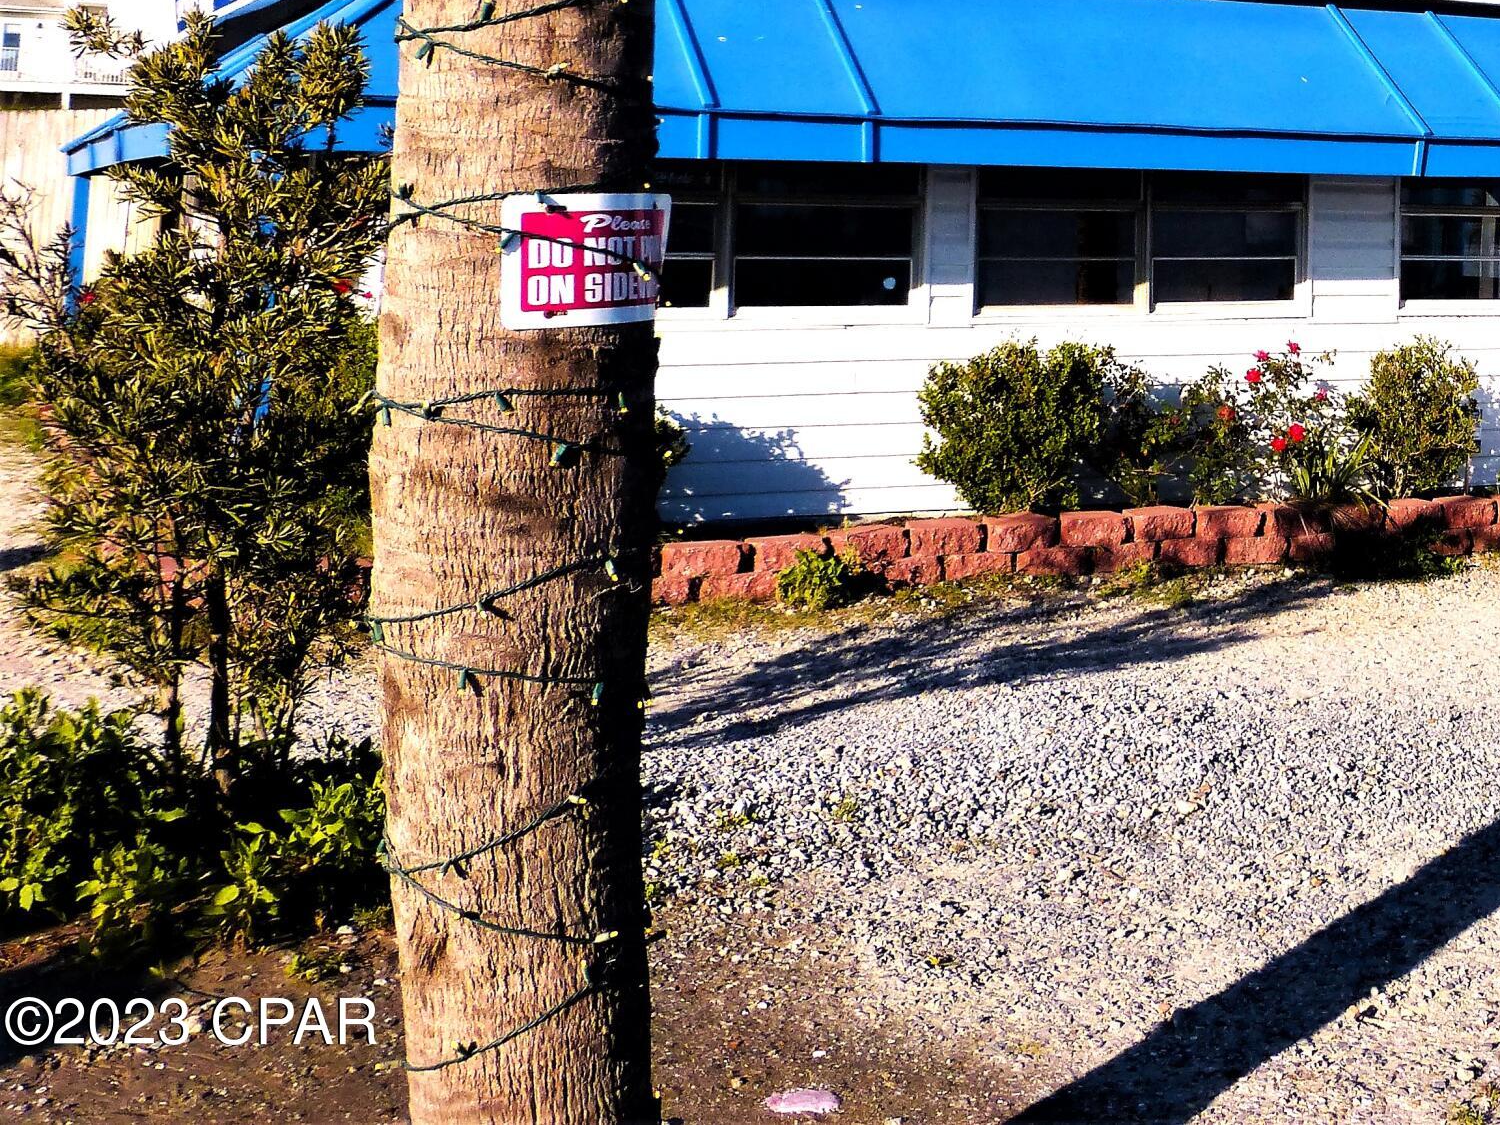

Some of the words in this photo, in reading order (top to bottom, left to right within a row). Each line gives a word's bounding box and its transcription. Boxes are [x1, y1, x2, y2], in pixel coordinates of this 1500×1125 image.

[579, 213, 651, 233] Please
[528, 237, 574, 269] DO
[583, 235, 636, 267] NOT
[527, 274, 575, 306] ON
